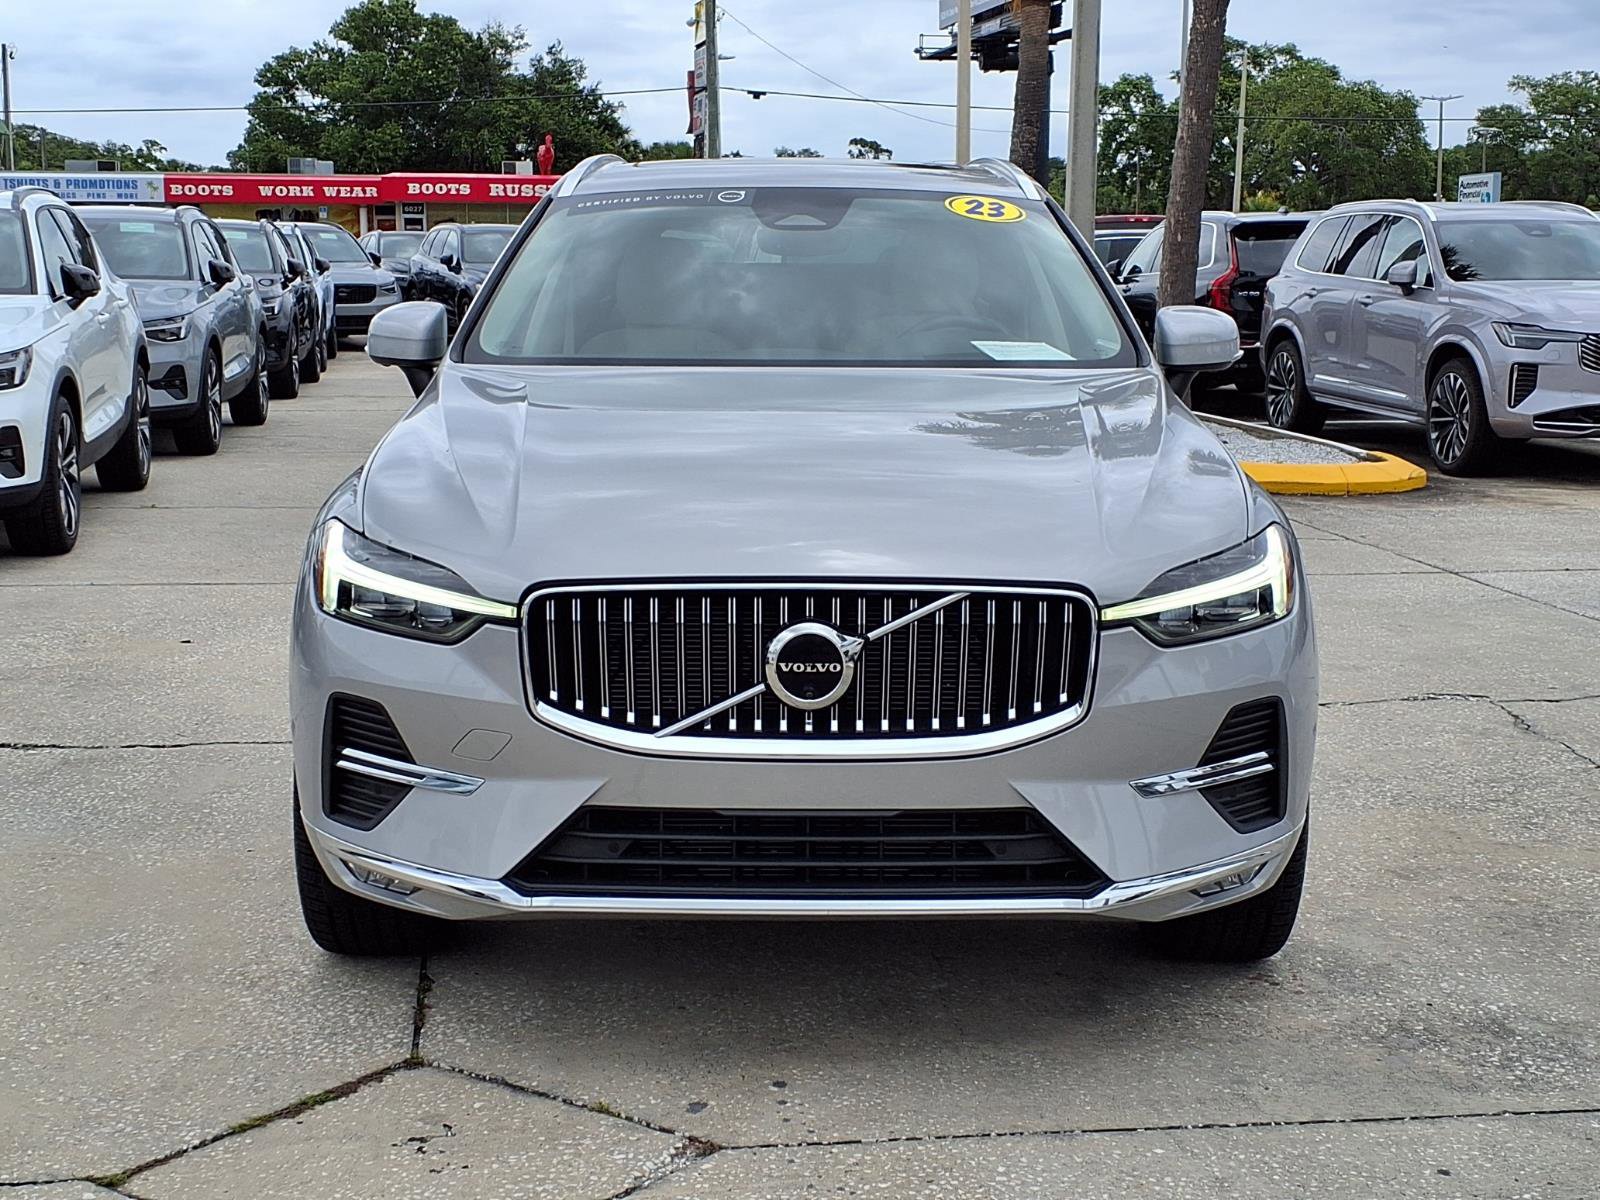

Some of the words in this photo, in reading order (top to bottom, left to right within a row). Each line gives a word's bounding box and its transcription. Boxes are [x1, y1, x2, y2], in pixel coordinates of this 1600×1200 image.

[66, 179, 138, 190] PROMOTIONS
[169, 184, 234, 196] BOOTS
[407, 183, 471, 195] BOOTS
[488, 183, 553, 197] RUSS
[1460, 180, 1489, 189] Automotive
[257, 185, 315, 197] WORK
[322, 186, 378, 198] WEAR
[577, 197, 640, 208] CERTIFIED
[964, 199, 1005, 218] 23
[778, 662, 842, 673] VOLVO
